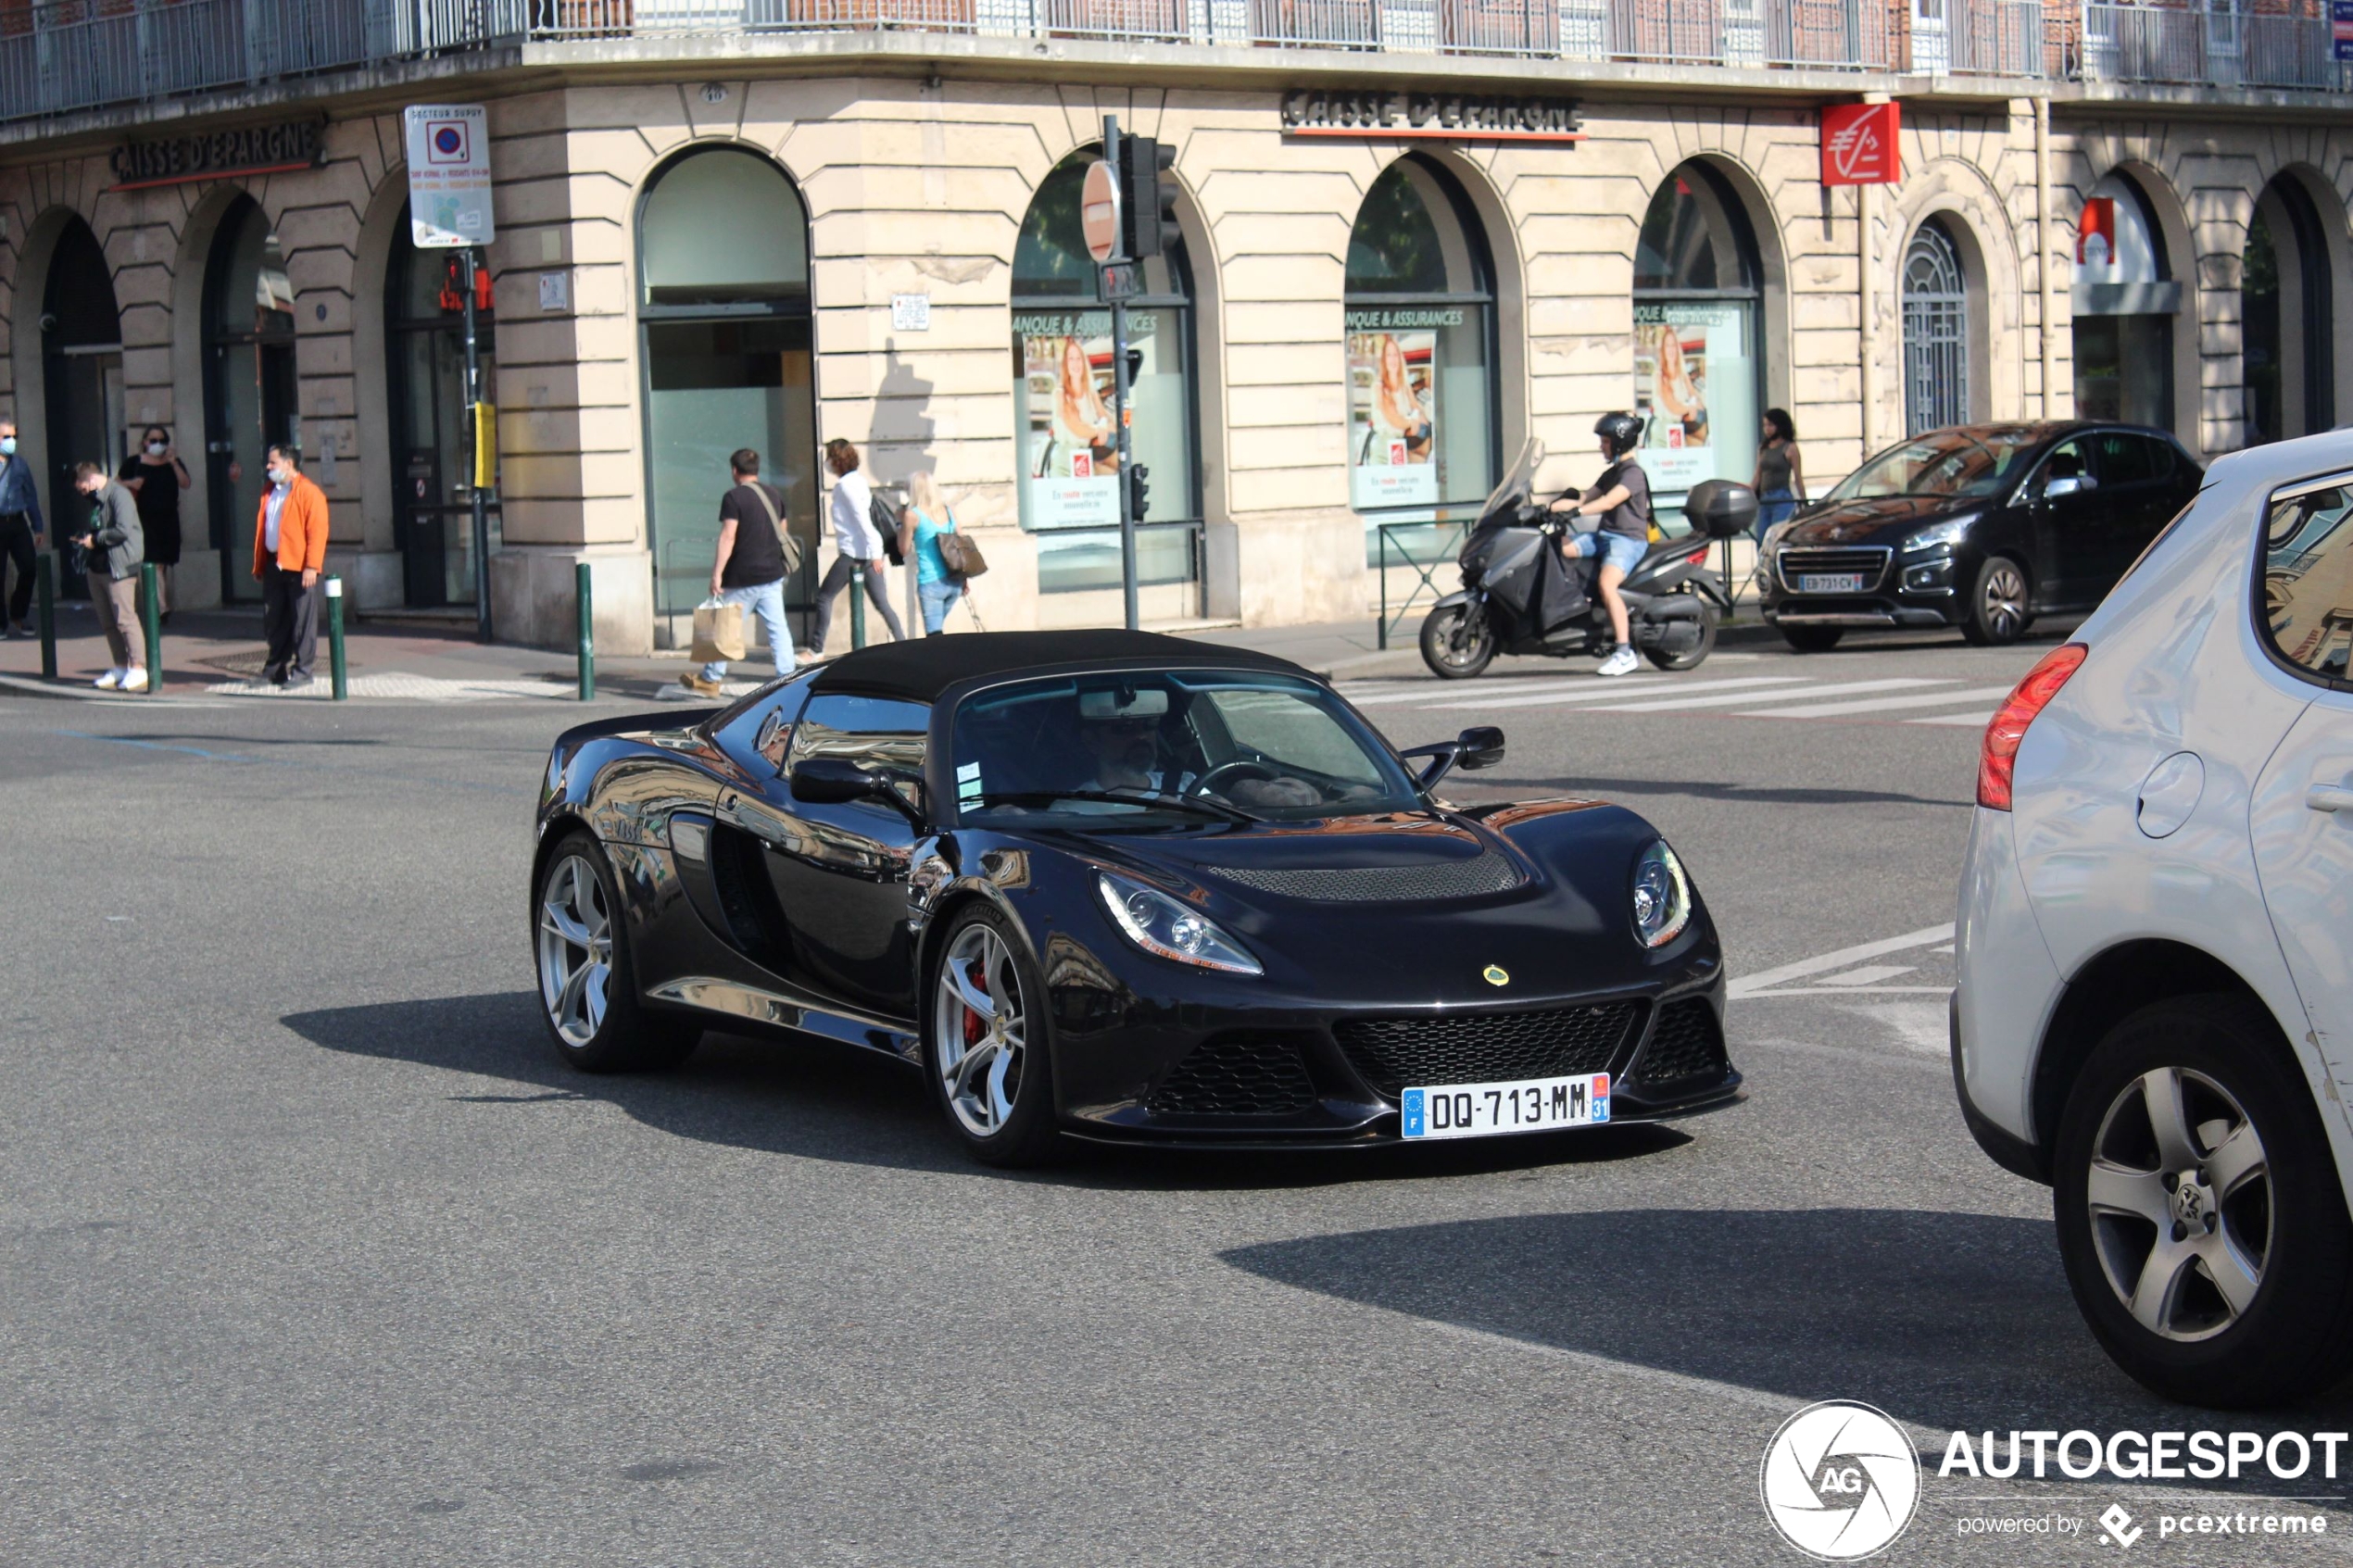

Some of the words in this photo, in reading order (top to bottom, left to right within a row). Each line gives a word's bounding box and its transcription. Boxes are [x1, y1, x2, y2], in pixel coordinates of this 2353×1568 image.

[412, 109, 451, 119] SECTEUR
[1285, 91, 1400, 127] CAISSE
[1406, 94, 1583, 131] D'EPARGNE
[109, 140, 180, 180] CAISSE
[190, 123, 313, 169] D'EPARGNE
[1063, 316, 1074, 332] &
[1075, 316, 1157, 332] ASSURNCES
[1381, 311, 1391, 326] &
[1391, 310, 1463, 326] ASSURANCES
[1411, 1118, 1417, 1128] F
[1432, 1083, 1586, 1130] DQ-713-MM
[1593, 1098, 1607, 1118] 31
